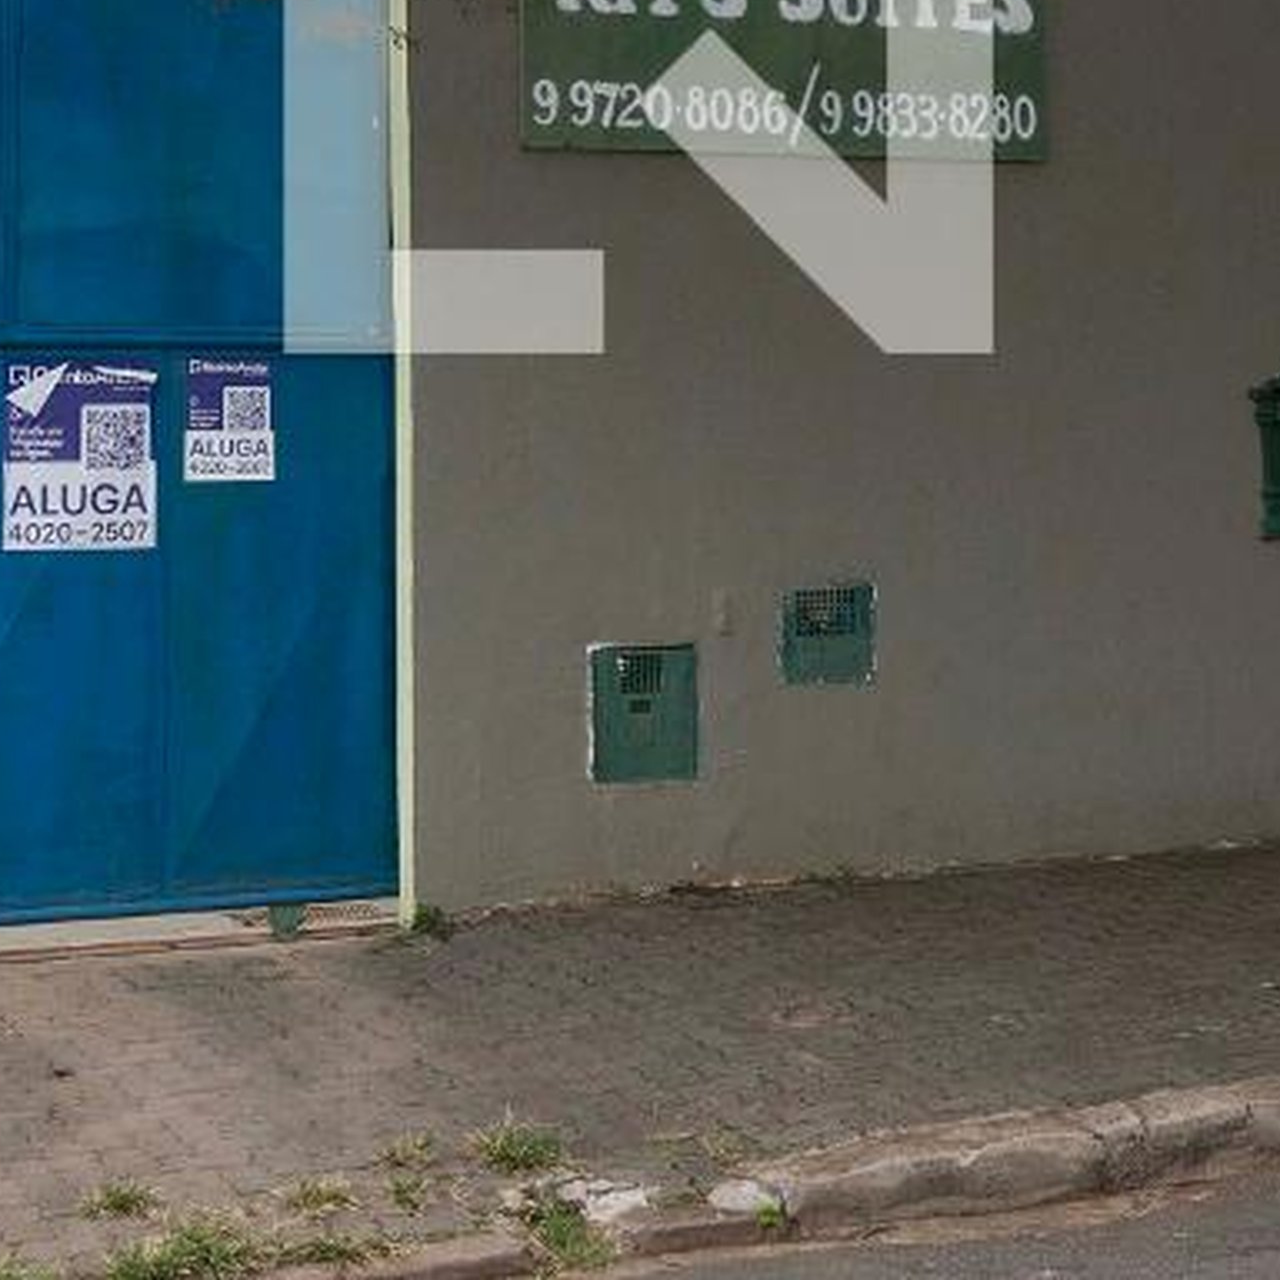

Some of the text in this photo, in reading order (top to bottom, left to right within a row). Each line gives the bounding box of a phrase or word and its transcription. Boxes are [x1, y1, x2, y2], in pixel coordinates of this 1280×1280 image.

[188, 439, 270, 457] ALUGA
[9, 483, 148, 517] ALUGA
[9, 520, 148, 545] 4020-2507
